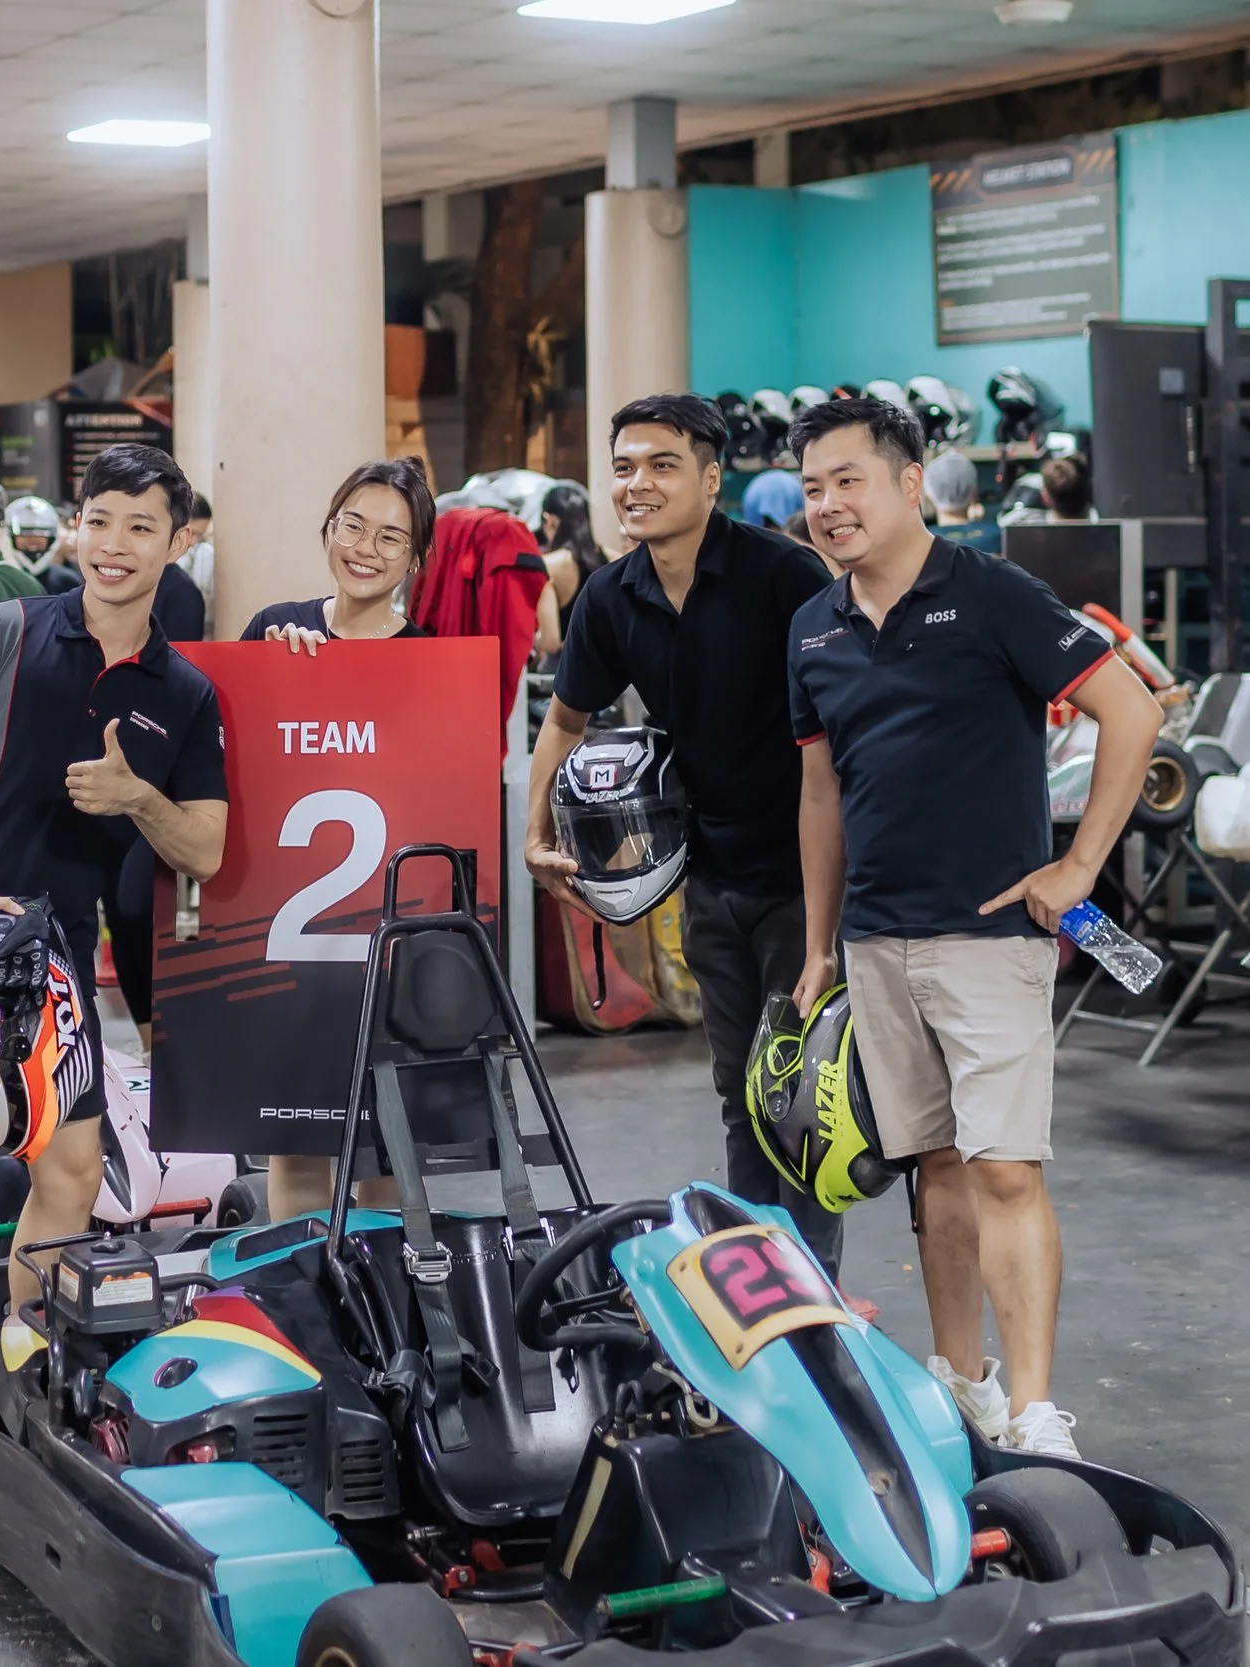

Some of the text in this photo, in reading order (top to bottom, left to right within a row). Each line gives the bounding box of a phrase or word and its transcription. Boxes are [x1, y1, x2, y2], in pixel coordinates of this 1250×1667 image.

[924, 609, 957, 625] BOSS
[277, 720, 377, 755] TEAM
[594, 769, 611, 783] M
[265, 789, 387, 962] 2
[815, 1060, 840, 1141] LAZER
